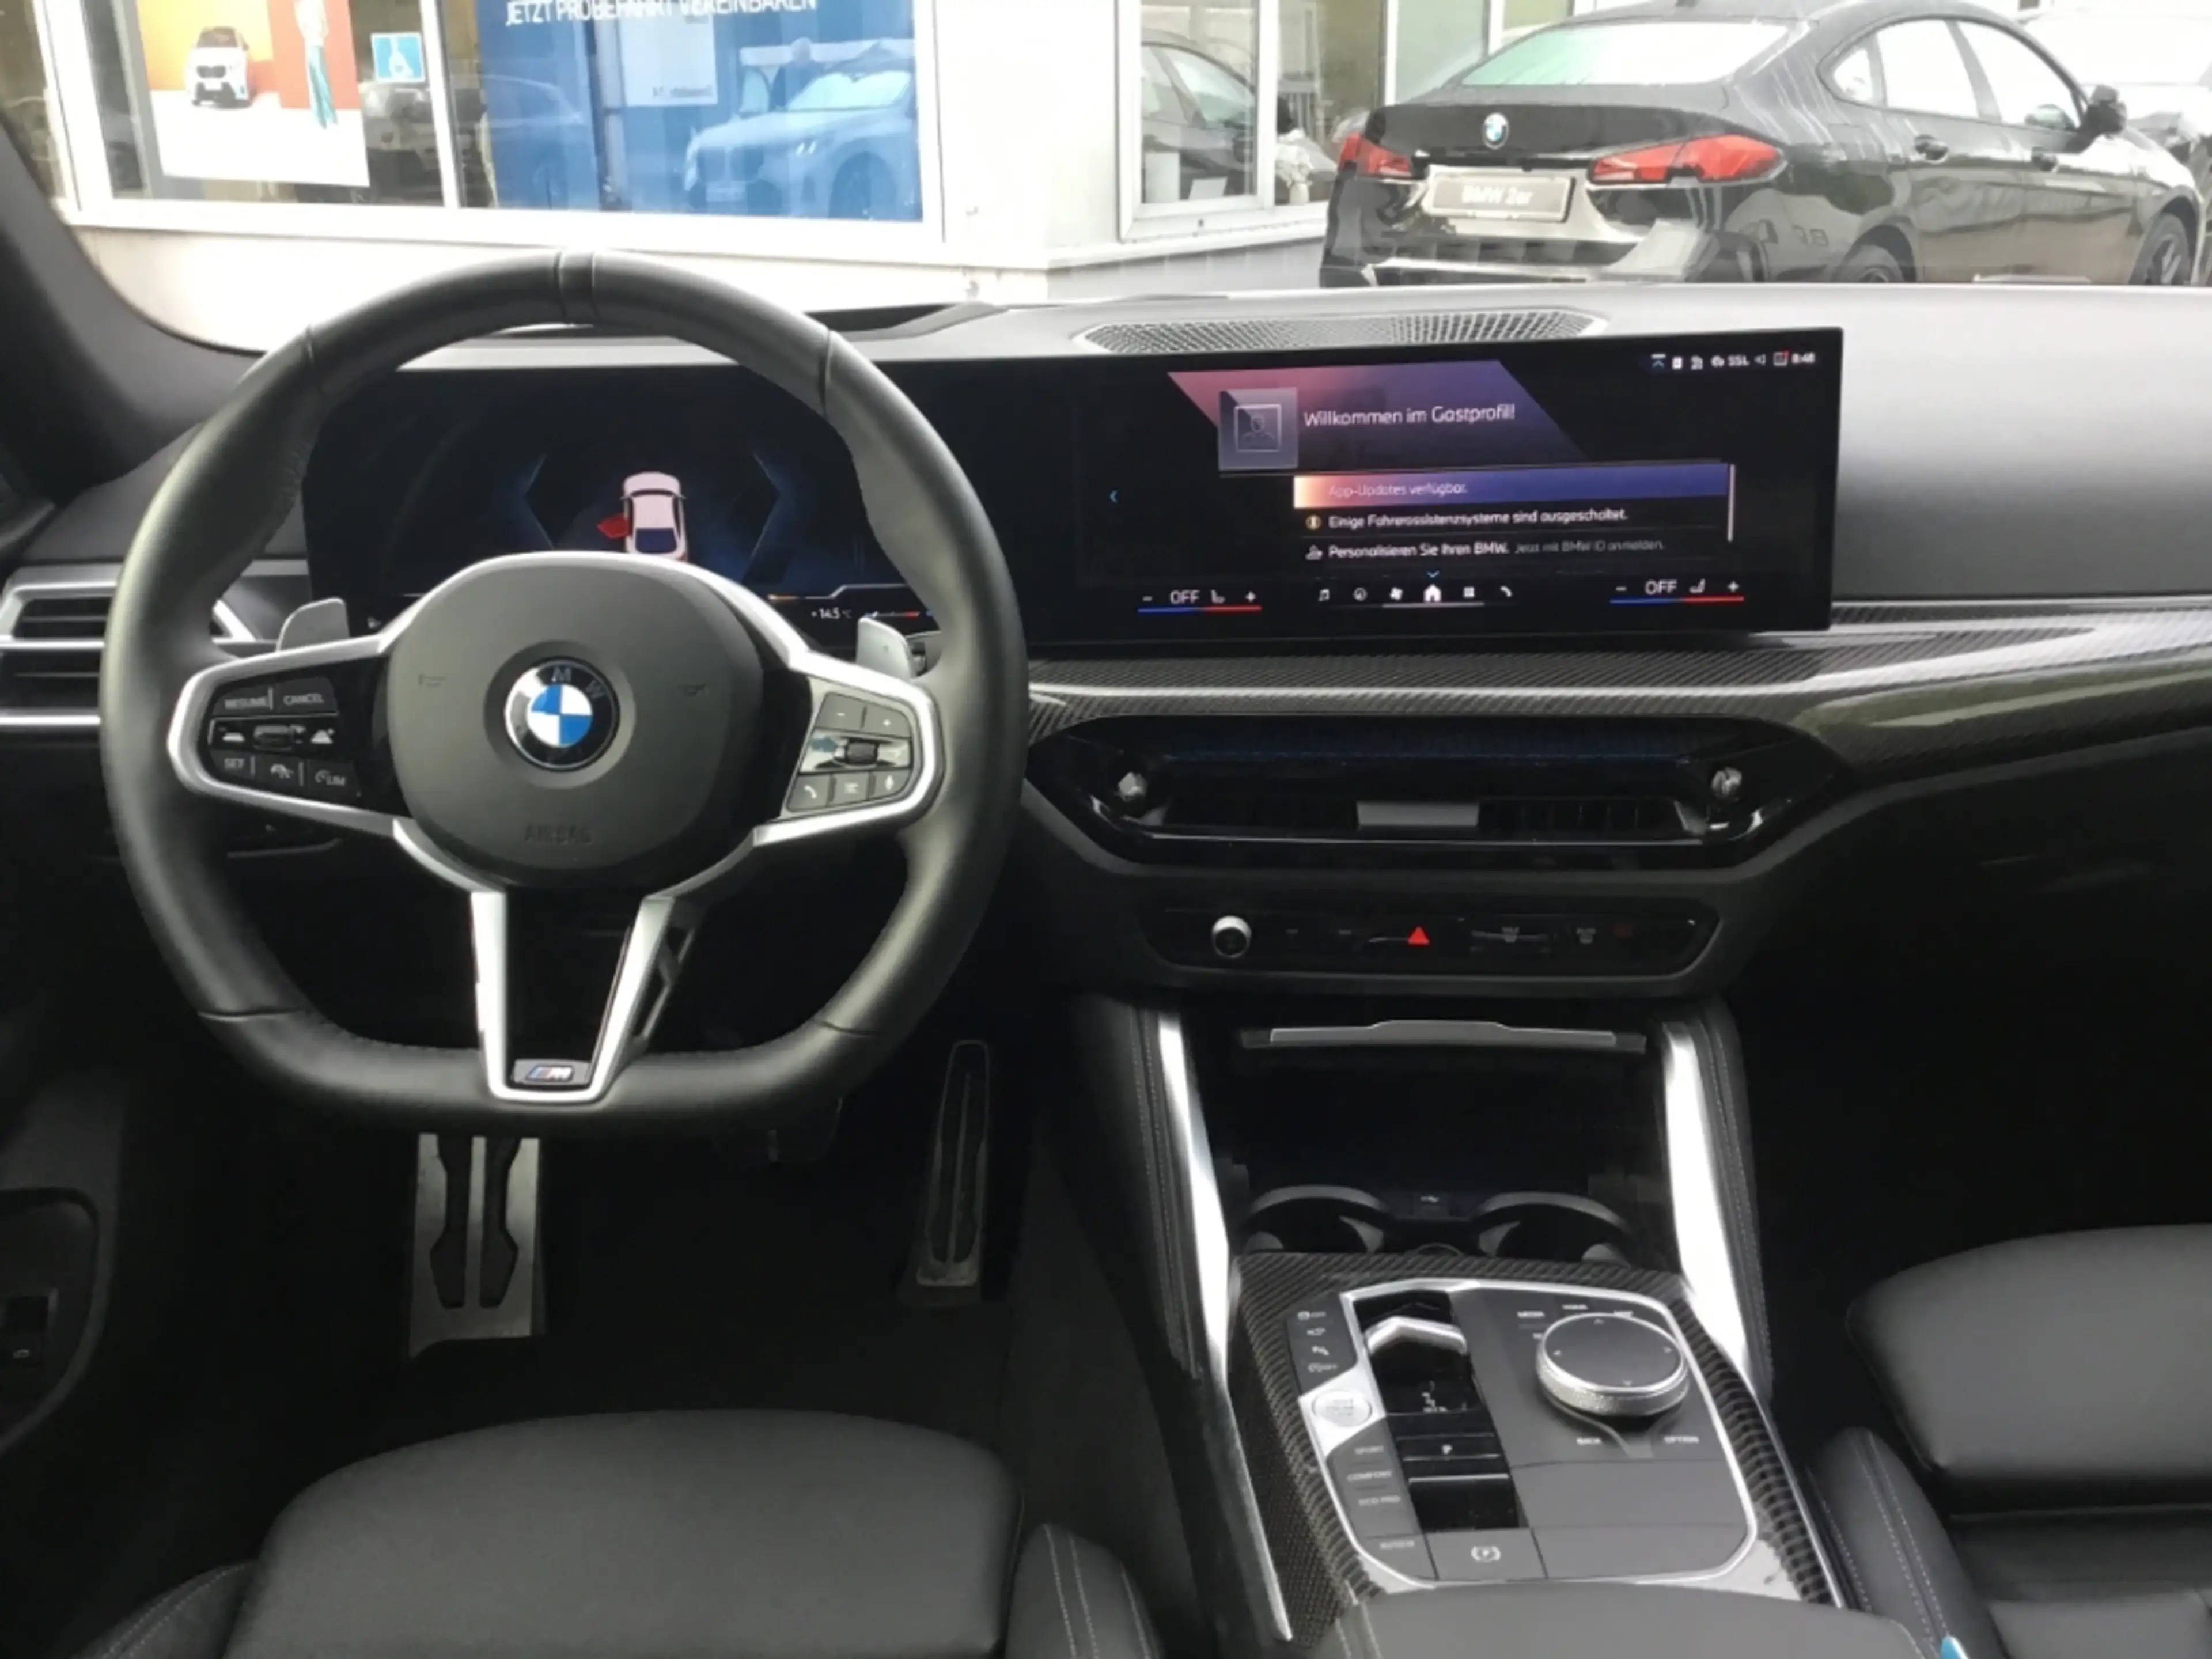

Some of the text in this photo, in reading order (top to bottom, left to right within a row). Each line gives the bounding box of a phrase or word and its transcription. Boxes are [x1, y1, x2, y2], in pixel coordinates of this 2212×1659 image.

[505, 2, 551, 26] JETZT
[1304, 403, 1516, 427] Willkommen im Gastprofil!
[1329, 484, 1406, 498] App-Updates
[1328, 515, 1365, 529] Einige
[1512, 510, 1538, 524] sind
[1328, 545, 1418, 558] Personalisieren
[1419, 542, 1439, 556] Sie
[1645, 579, 1677, 595] OFF
[1169, 589, 1200, 604] OFF
[283, 693, 324, 706] CANCEL
